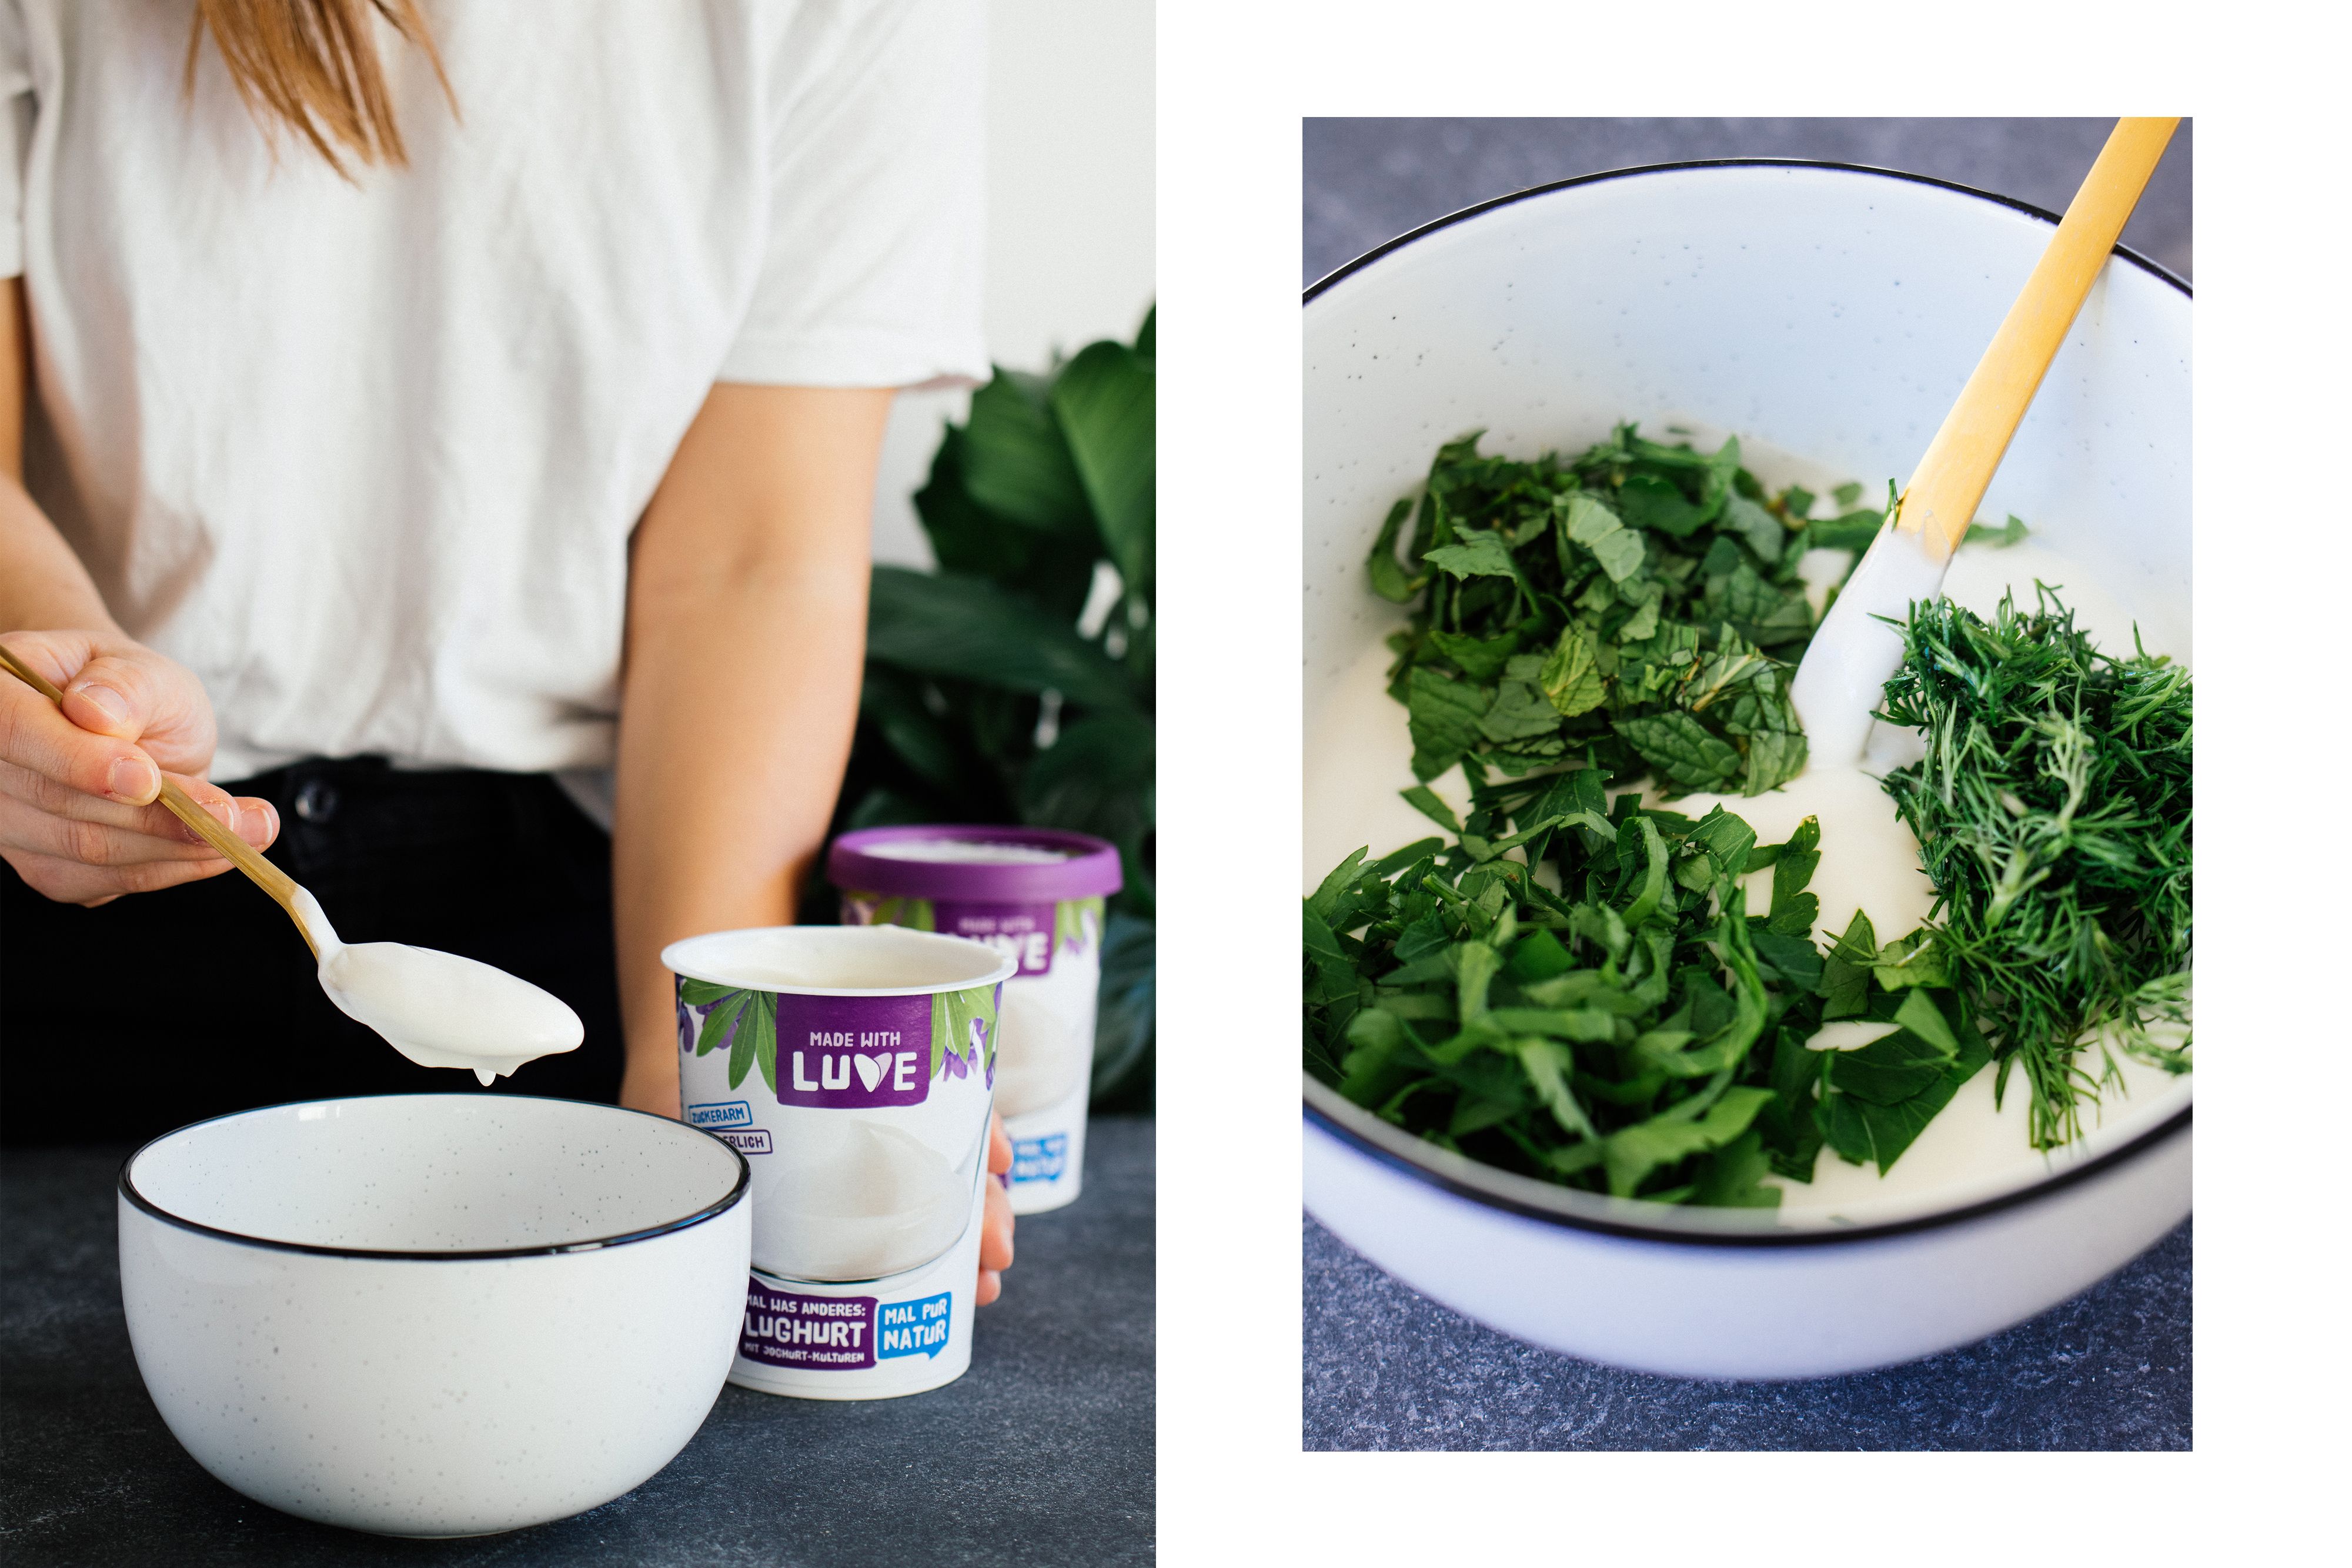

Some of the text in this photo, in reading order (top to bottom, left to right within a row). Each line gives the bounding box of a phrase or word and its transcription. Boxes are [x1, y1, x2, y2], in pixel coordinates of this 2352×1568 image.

[810, 1031, 901, 1048] MADE WITH
[793, 1051, 917, 1093] LUVE
[691, 1107, 745, 1124] ZUCKERARM
[723, 1135, 764, 1148] RLICH
[770, 1298, 797, 1313] WAS
[801, 1302, 866, 1317] ANDERES:
[884, 1298, 947, 1326] MAL PUR
[744, 1312, 867, 1348] LUGHURT
[883, 1319, 946, 1351] NATUR
[744, 1342, 760, 1352] MIT
